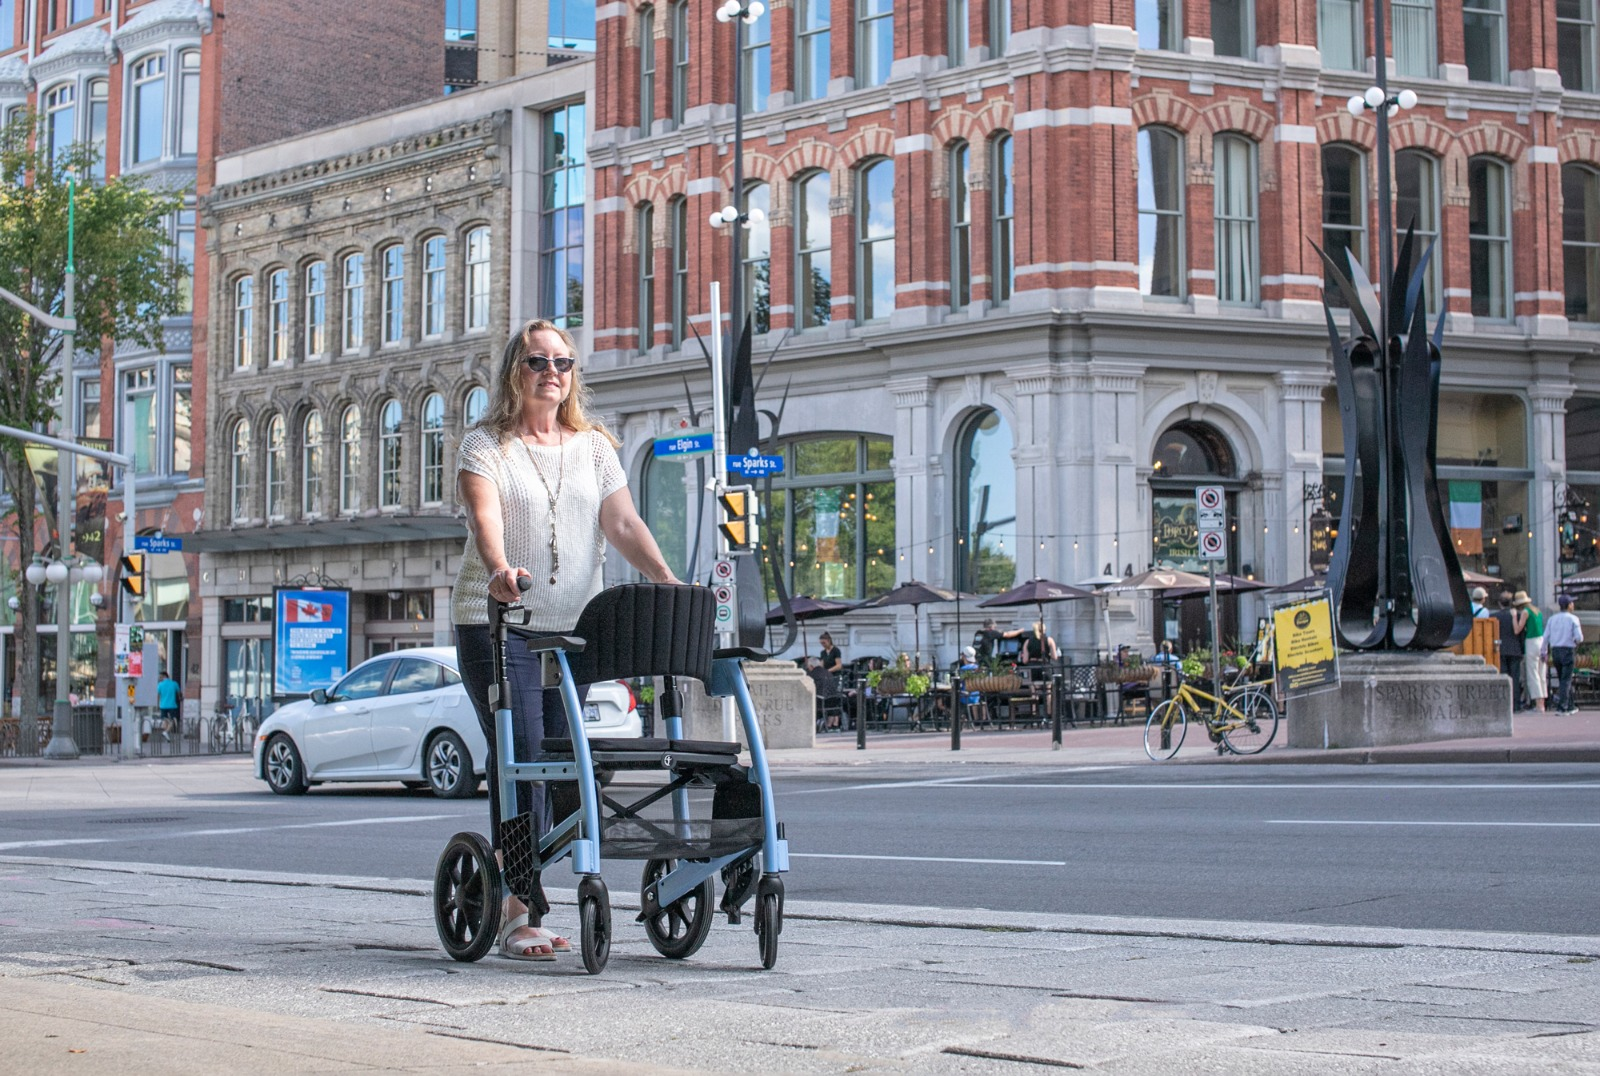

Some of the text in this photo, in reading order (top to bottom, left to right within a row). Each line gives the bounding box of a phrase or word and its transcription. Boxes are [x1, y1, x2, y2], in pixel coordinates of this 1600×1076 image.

[677, 438, 693, 452] Elgin
[743, 457, 768, 470] Sparks
[150, 538, 170, 549] Sparks
[1376, 684, 1508, 701] SPARKS STREET
[765, 698, 794, 712] RUE
[1420, 704, 1470, 720] MALL
